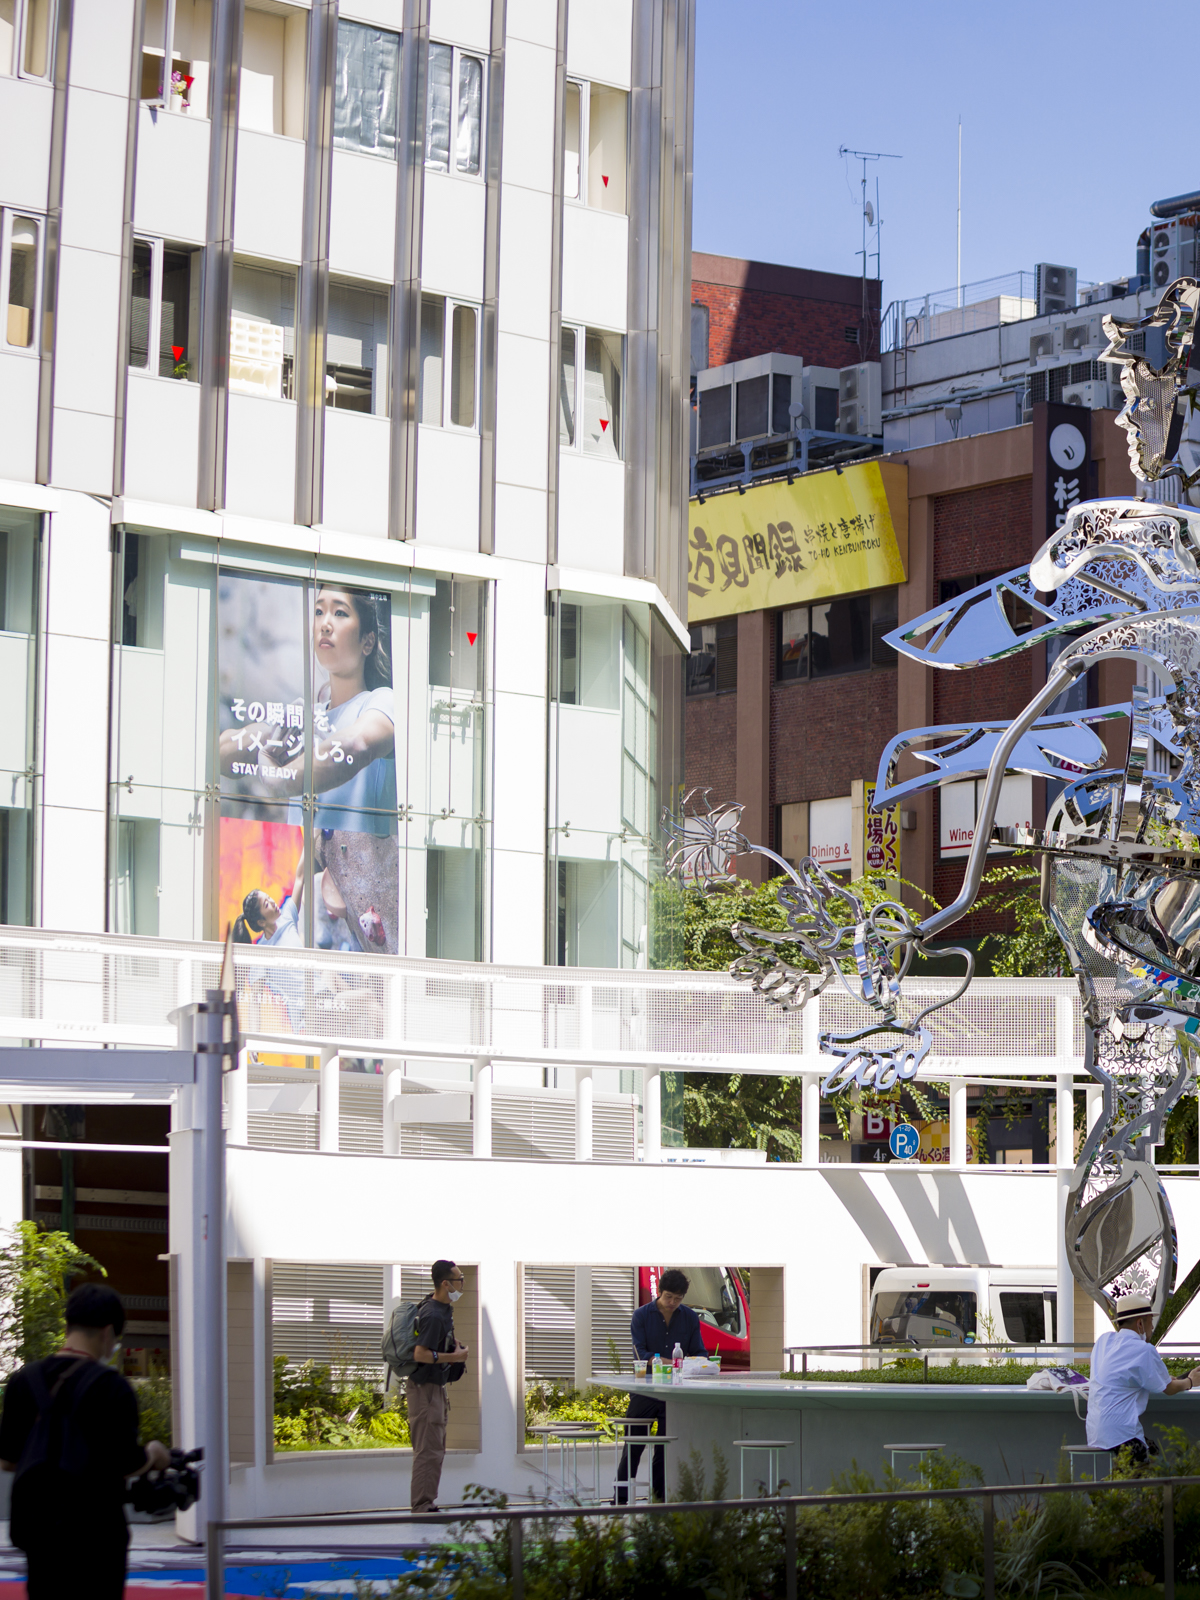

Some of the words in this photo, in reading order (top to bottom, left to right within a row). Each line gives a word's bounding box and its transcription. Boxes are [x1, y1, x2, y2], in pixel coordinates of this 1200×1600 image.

[688, 521, 808, 598] 方見聞録
[808, 547, 830, 561] TO-HO
[834, 538, 880, 556] KENBUNROKU
[231, 698, 337, 734] その瞬間を、
[231, 728, 354, 765] イメージしろ。
[232, 762, 259, 776] STAY
[262, 766, 297, 780] READY
[949, 829, 974, 842] Wine
[811, 845, 841, 859] Dining
[843, 843, 850, 854] &
[872, 1147, 888, 1163] 4F
[896, 1134, 908, 1155] P
[904, 1145, 913, 1155] 40
